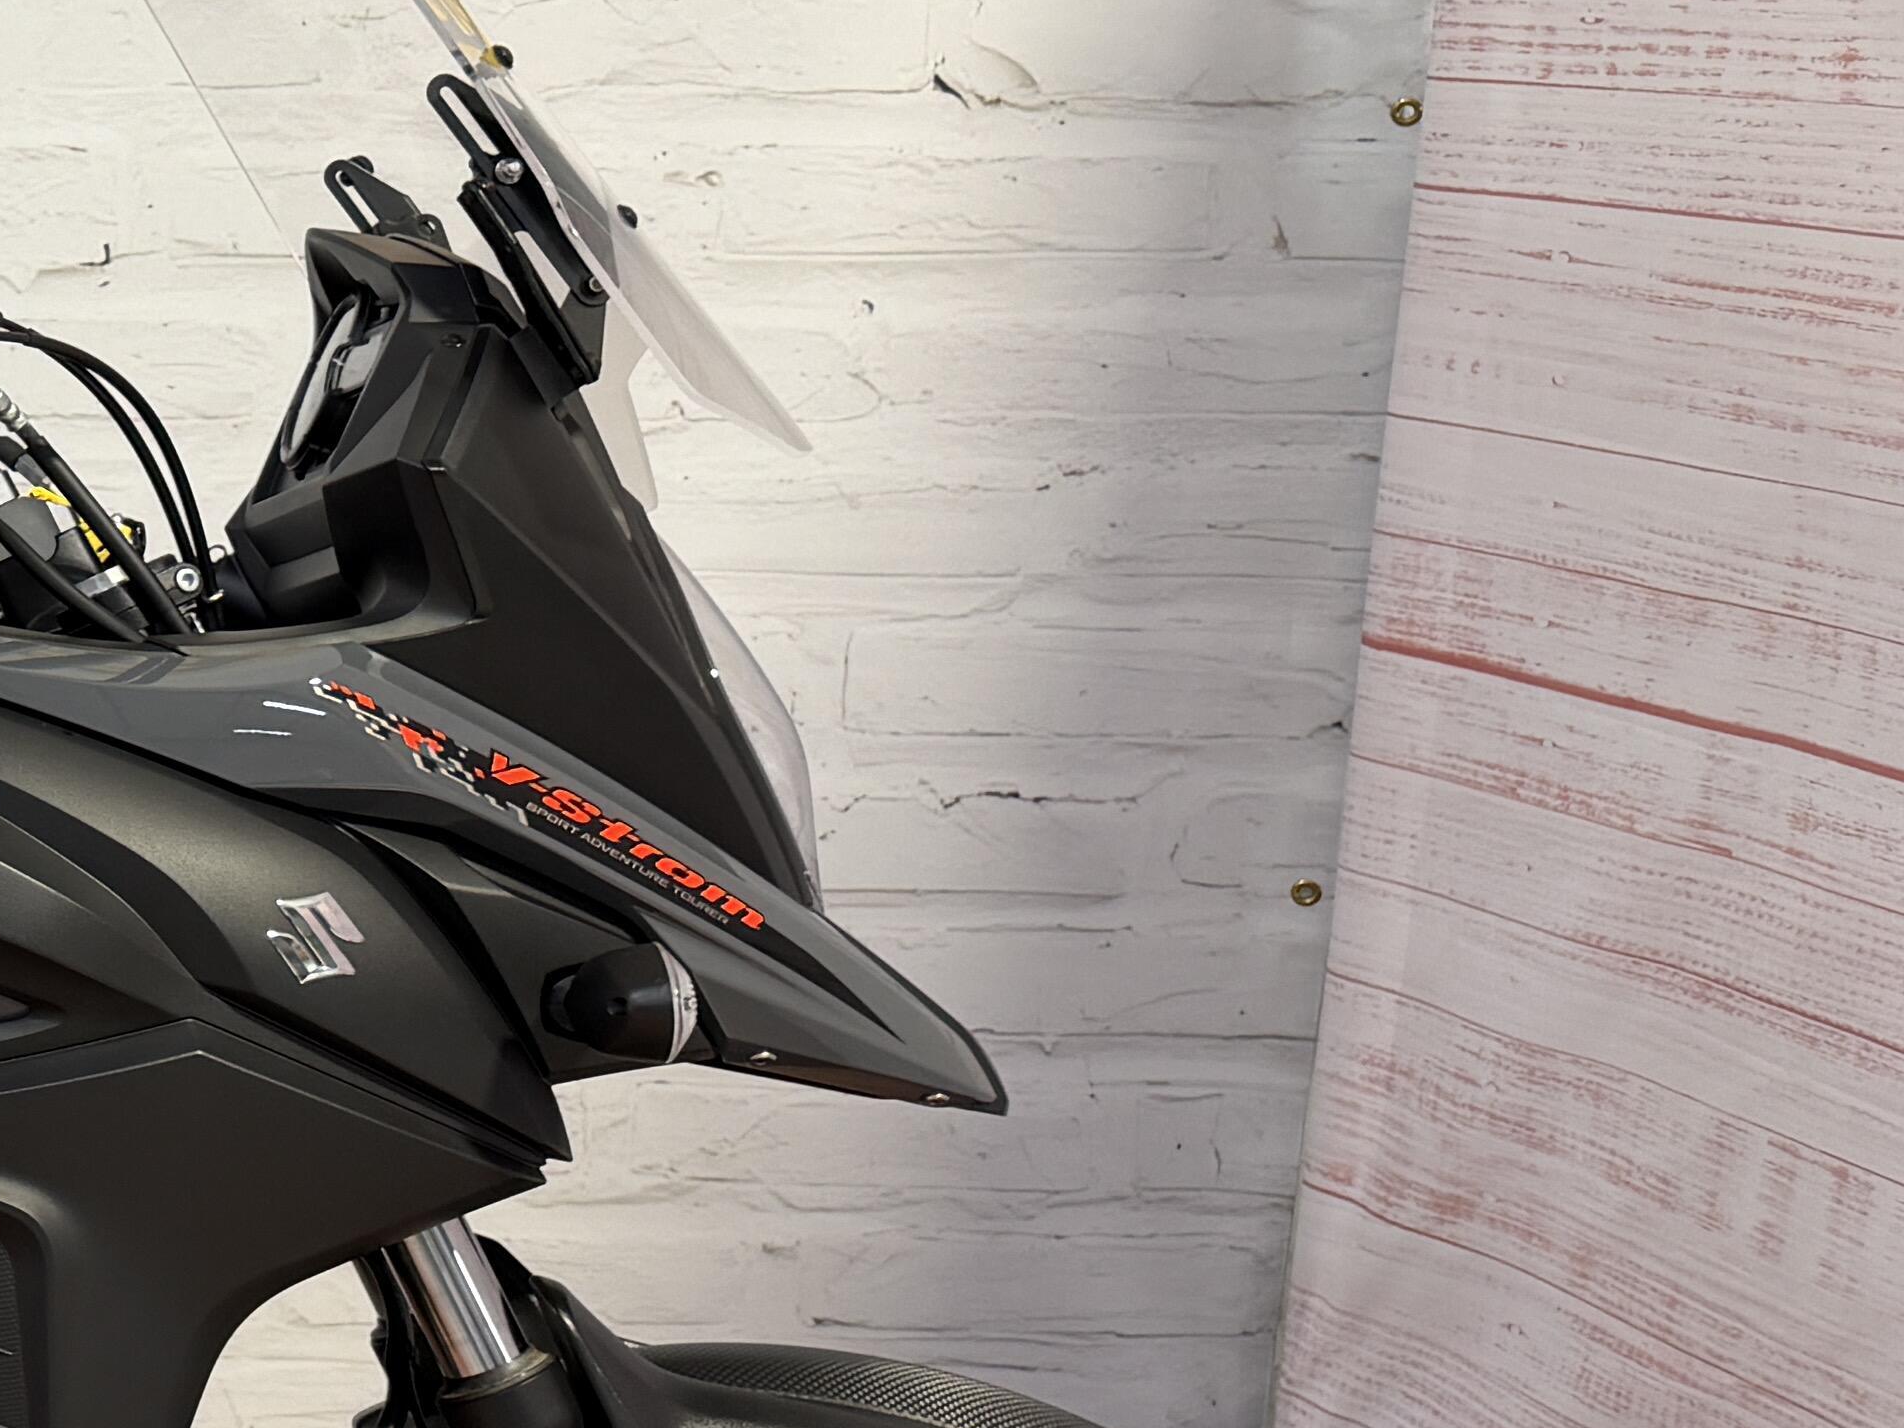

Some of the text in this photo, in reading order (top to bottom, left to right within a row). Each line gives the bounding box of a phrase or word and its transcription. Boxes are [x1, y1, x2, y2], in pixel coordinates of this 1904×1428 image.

[490, 751, 766, 931] V-Strom
[526, 801, 730, 926] SPORT ADVENTURE TOURER
